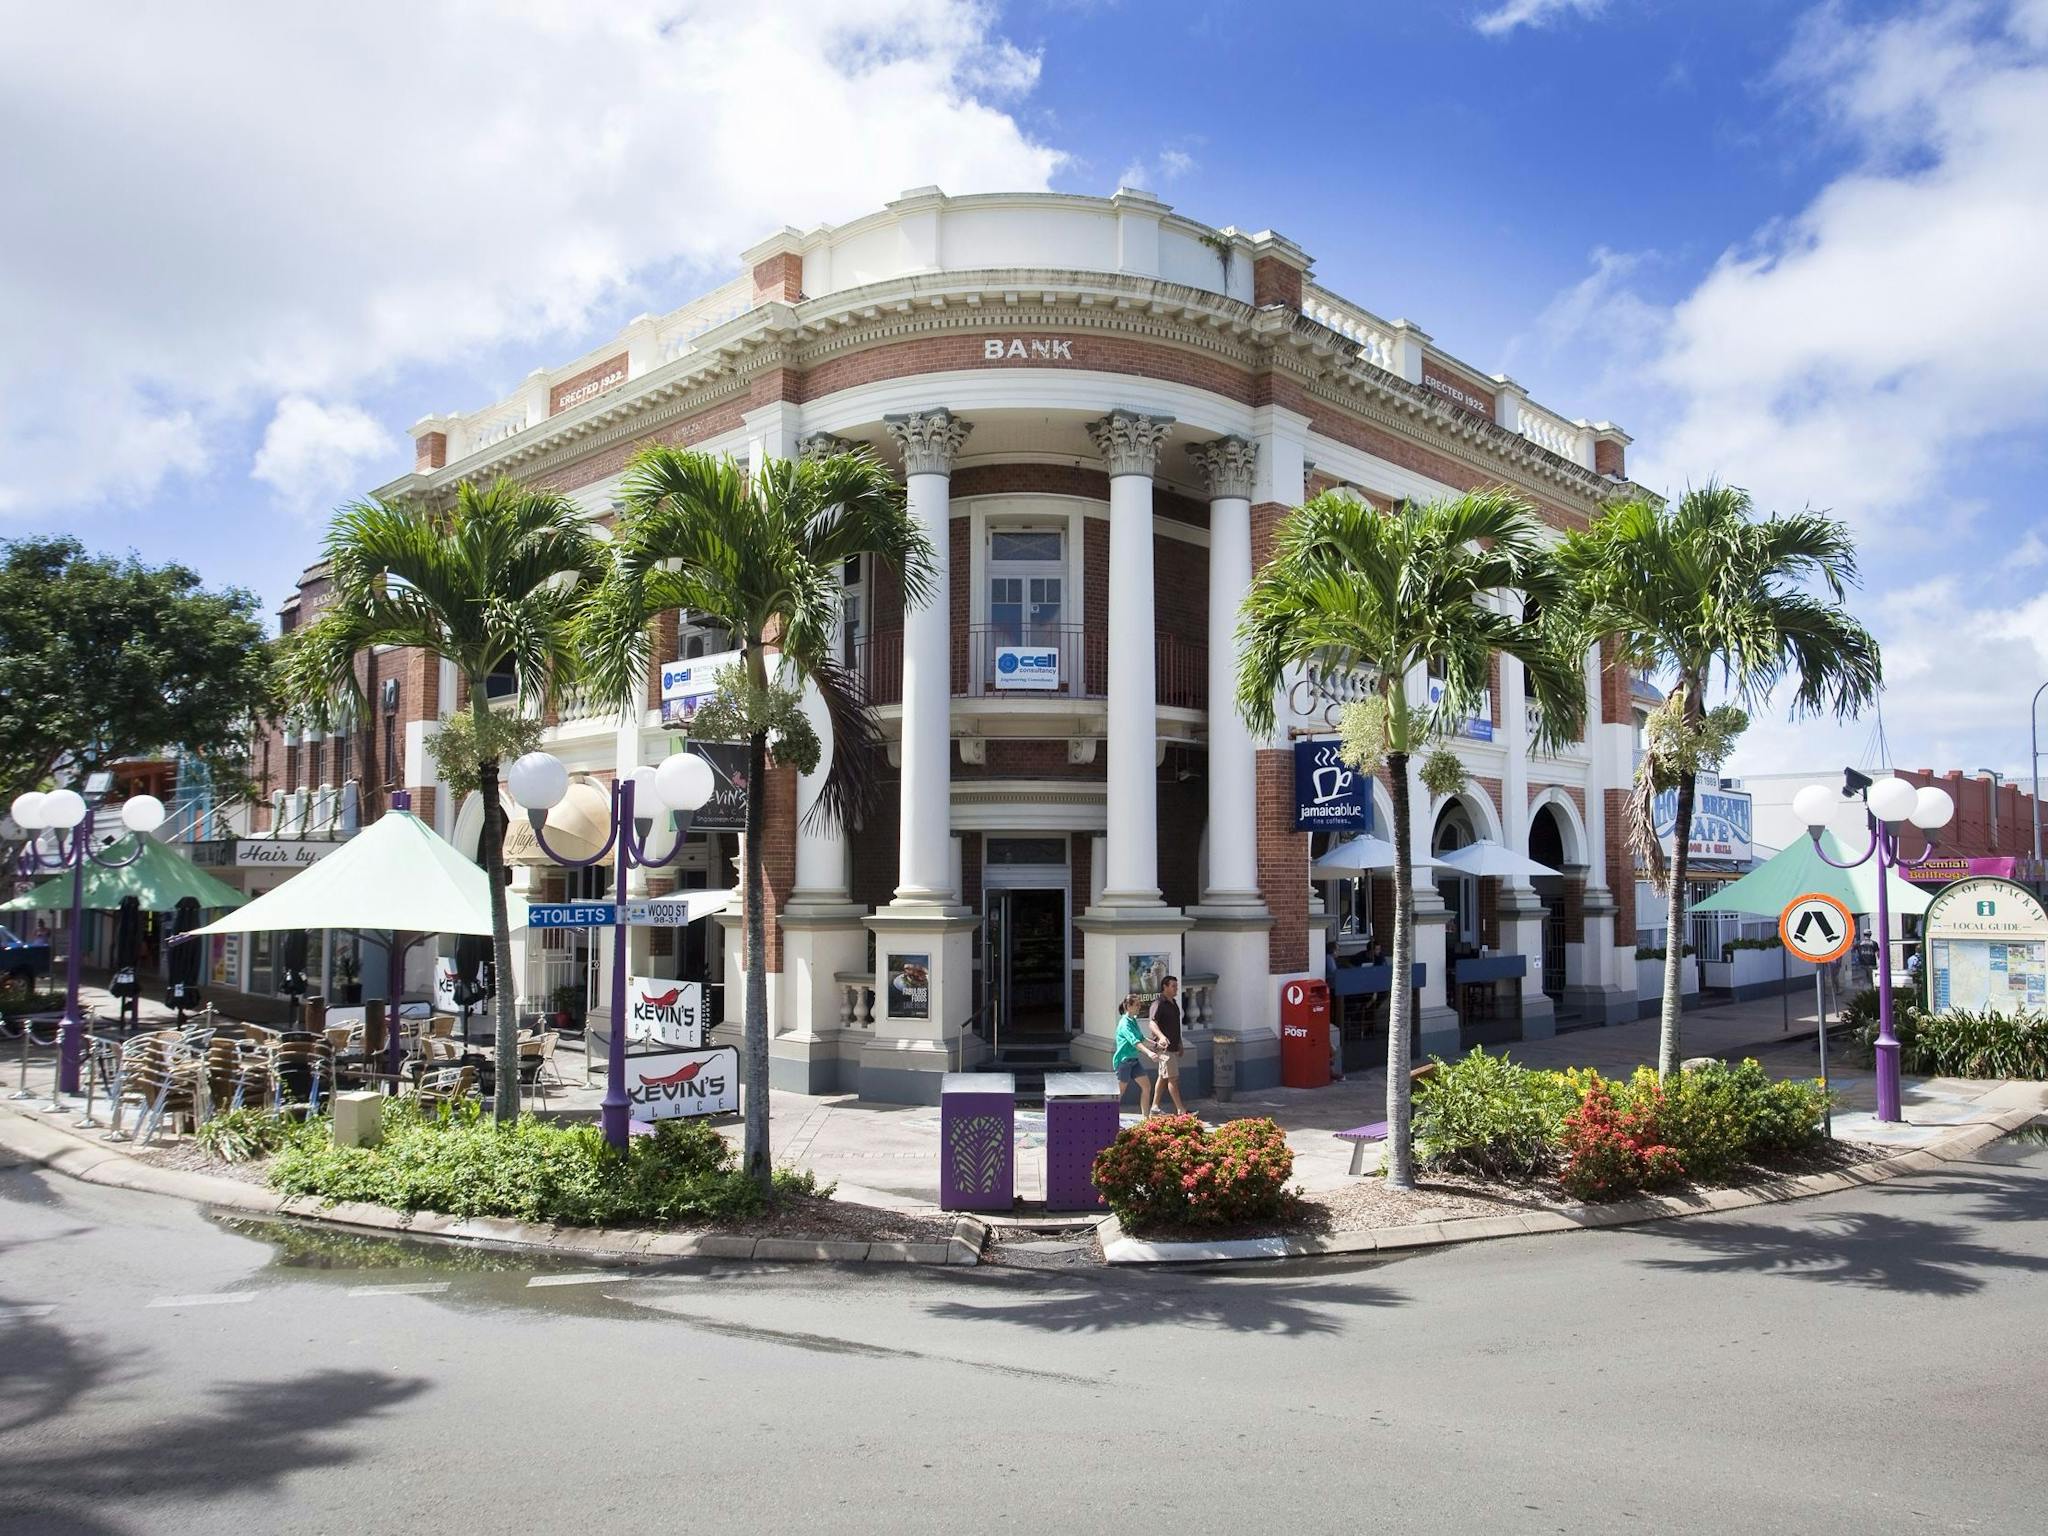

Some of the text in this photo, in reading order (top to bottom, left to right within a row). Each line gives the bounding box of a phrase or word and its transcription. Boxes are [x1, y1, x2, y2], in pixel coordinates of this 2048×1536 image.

[985, 339, 1072, 359] BANK
[560, 381, 599, 407] ERECTED
[1425, 375, 1463, 401] ERECTED
[1695, 775, 1703, 785] ST
[1300, 803, 1362, 820] jamaicablue
[1701, 794, 1750, 836] BREATH
[1689, 817, 1729, 842] AFE
[239, 845, 288, 862] Hair
[648, 904, 674, 917] WOOD
[676, 905, 686, 916] ST
[1932, 883, 2044, 921] CITY OF MACKAY
[541, 908, 606, 923] TOILETS
[1953, 922, 2020, 930] LOCAL GUIDE
[634, 1003, 695, 1027] KEVIN'S
[1284, 1028, 1308, 1038] POST
[627, 1076, 725, 1104] KEVIN'S
[629, 1098, 724, 1119] PLACE
